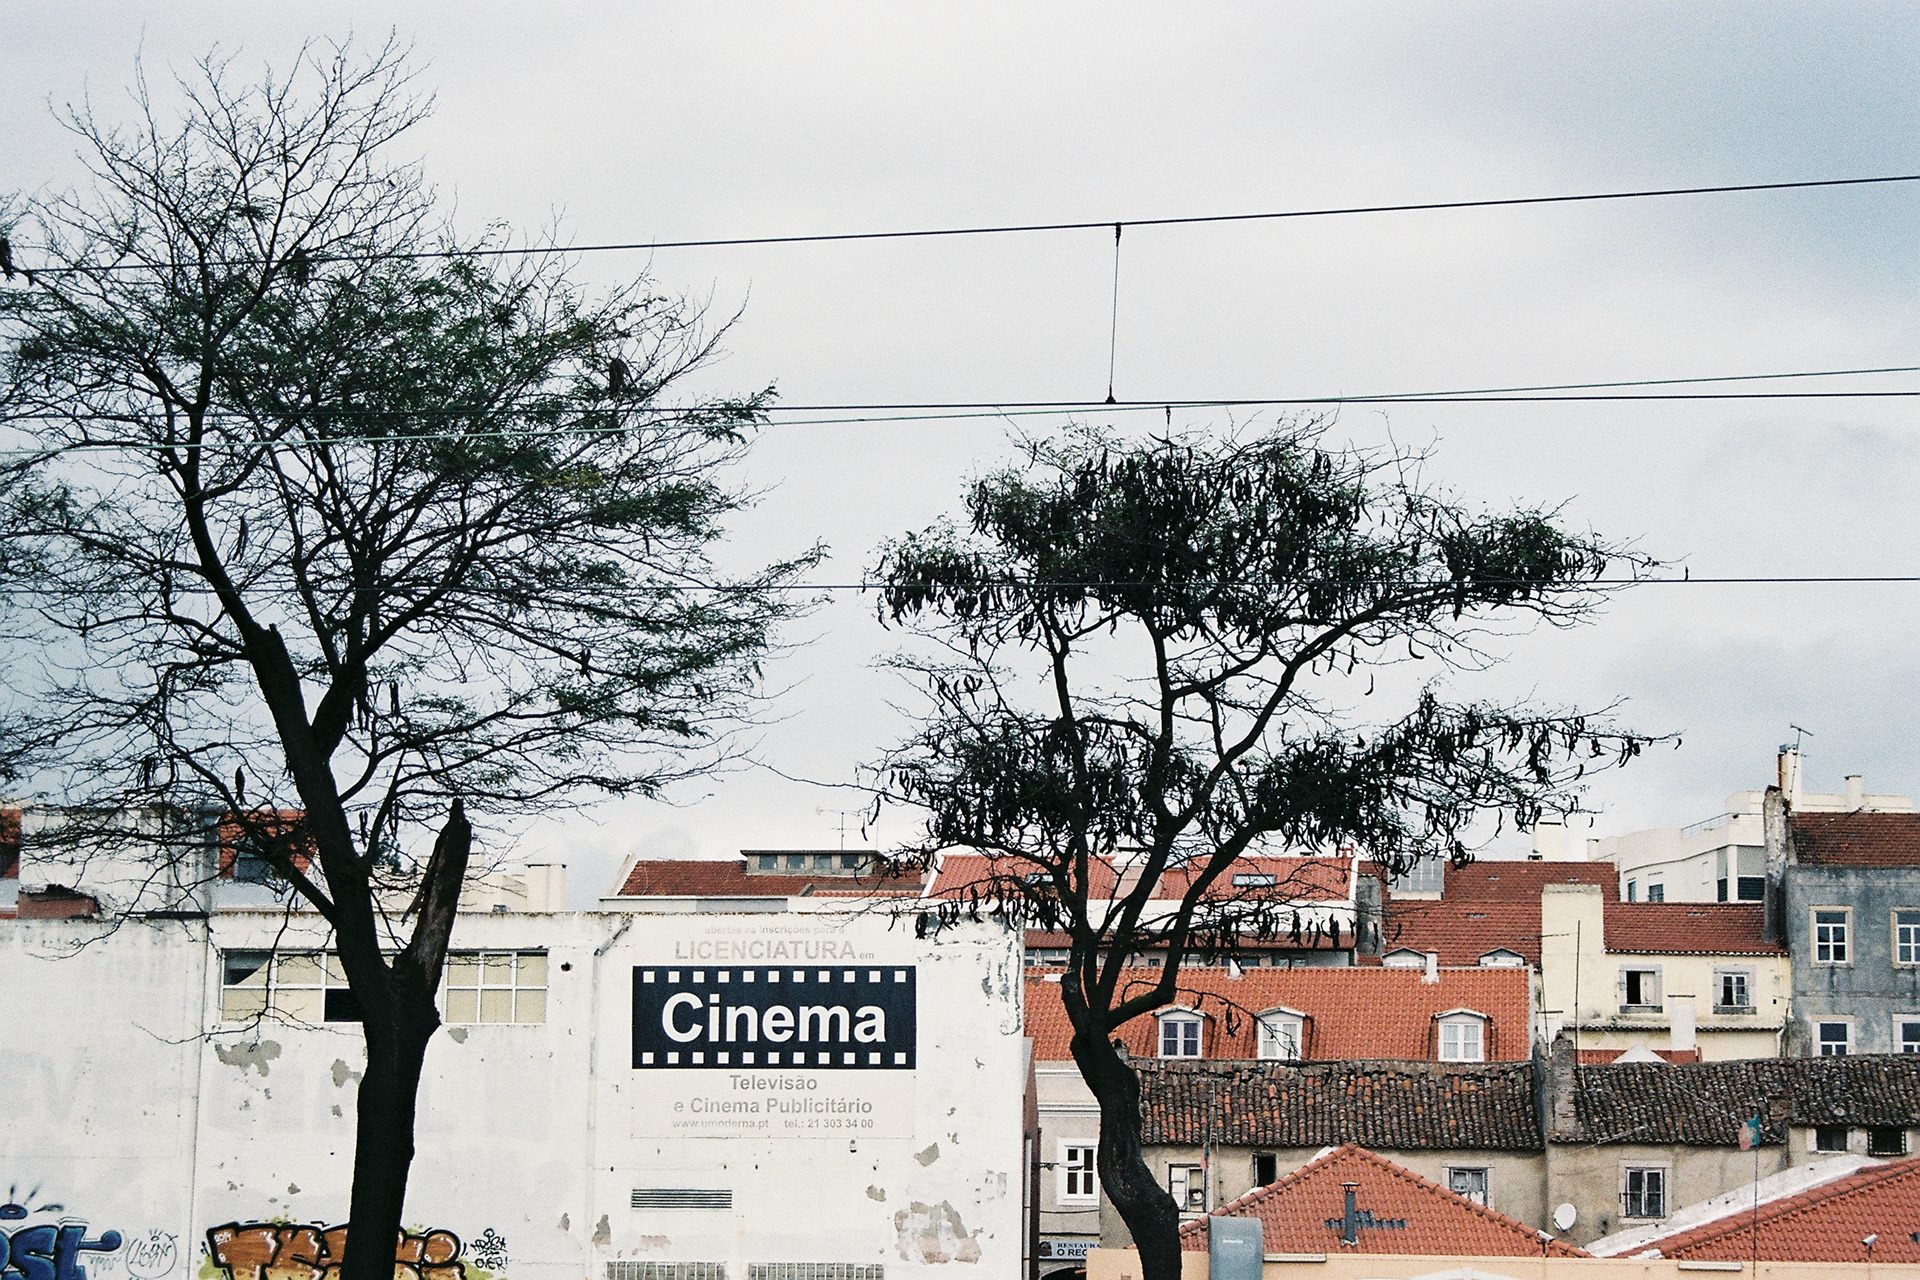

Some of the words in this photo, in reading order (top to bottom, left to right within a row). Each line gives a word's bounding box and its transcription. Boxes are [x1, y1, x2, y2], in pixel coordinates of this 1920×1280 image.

[674, 940, 857, 960] LICENCIATURA
[859, 951, 875, 960] em
[661, 992, 887, 1043] Cinema
[729, 1074, 818, 1091] Televisão
[673, 1101, 684, 1113] e
[690, 1097, 760, 1114] Cinema
[766, 1097, 873, 1114] Publicitário
[807, 1118, 820, 1129] 21
[823, 1118, 842, 1129] 303
[845, 1118, 858, 1129] 34
[860, 1118, 874, 1129] 00
